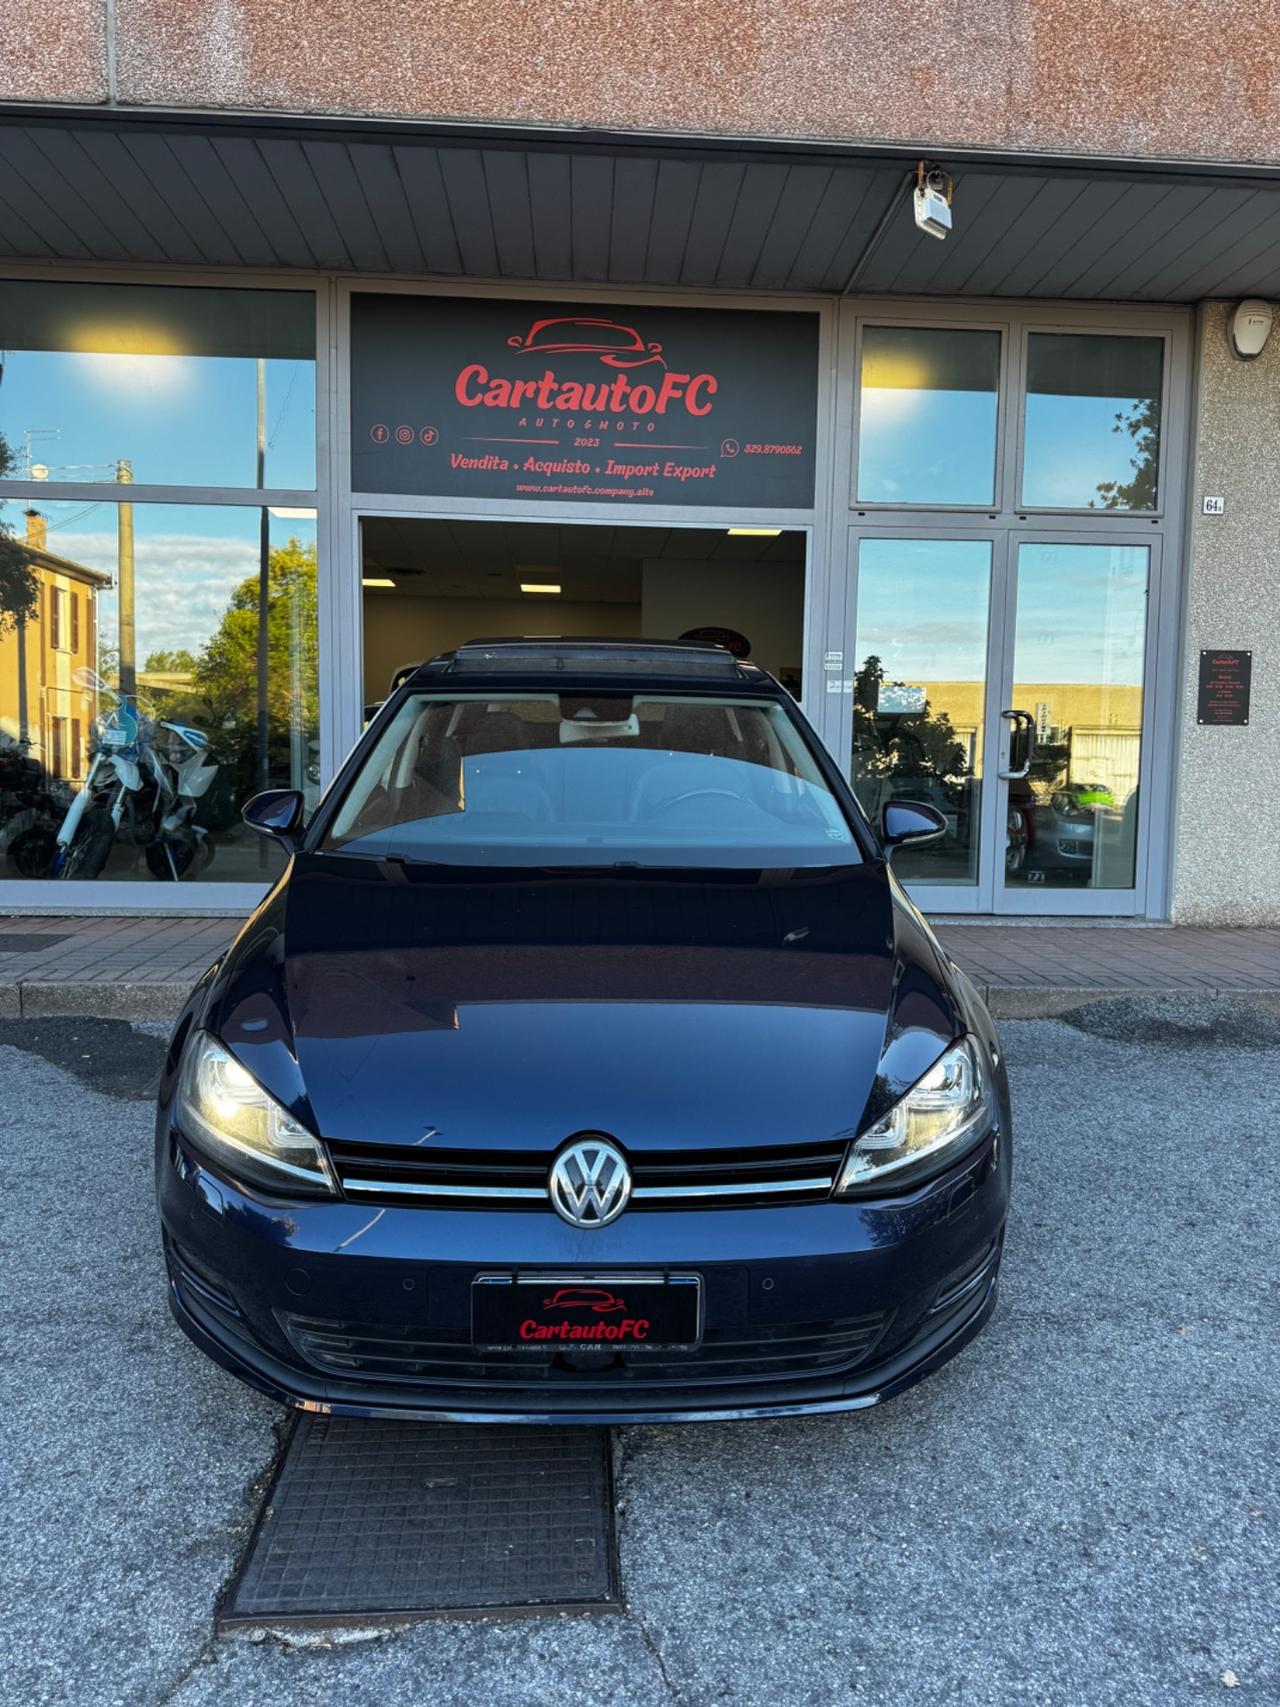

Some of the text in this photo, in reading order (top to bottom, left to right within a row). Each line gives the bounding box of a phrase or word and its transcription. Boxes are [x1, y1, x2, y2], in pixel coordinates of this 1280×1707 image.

[454, 363, 719, 417] CartautoFC
[573, 437, 601, 448] 2023
[450, 453, 717, 480] Vendita Acquisto Import Export
[516, 484, 655, 498] www.cartautofc.company.site
[519, 1318, 651, 1341] CartautoFC
